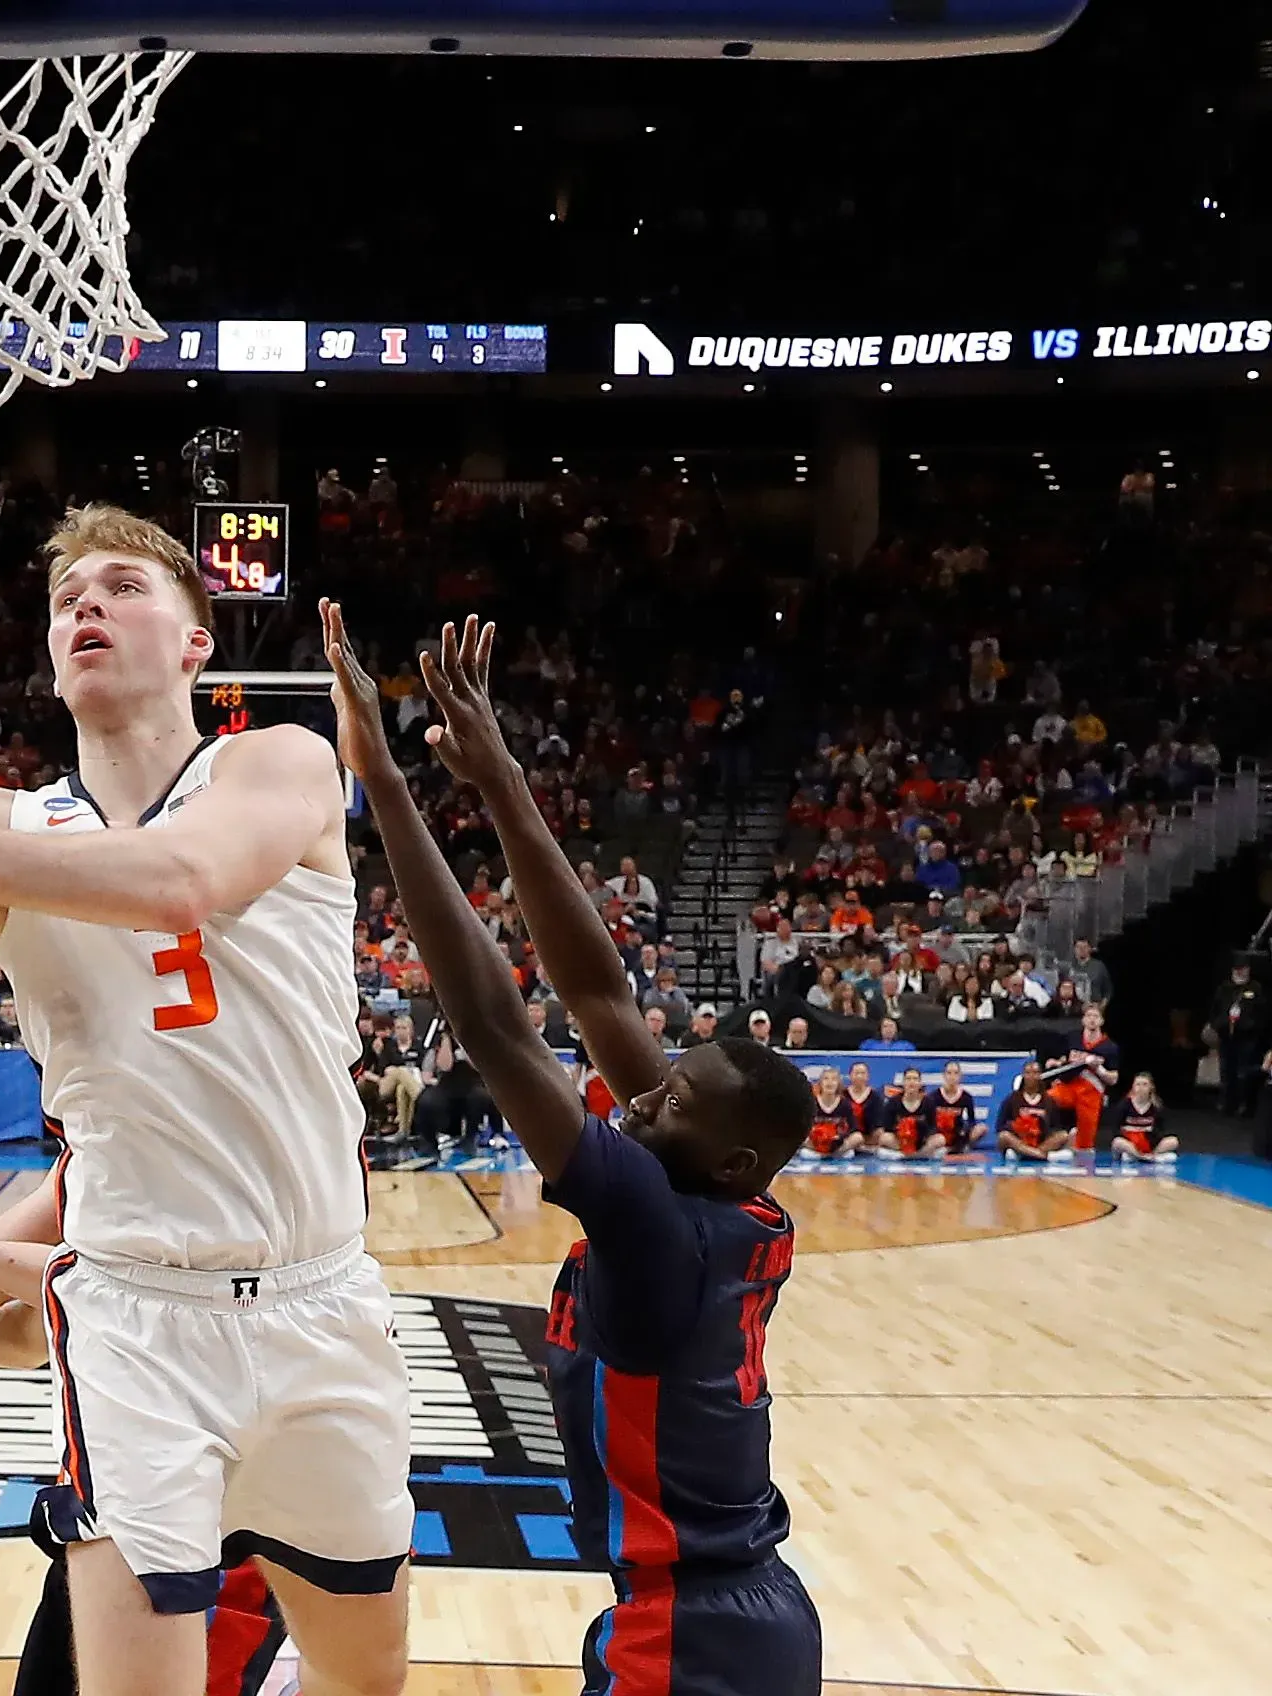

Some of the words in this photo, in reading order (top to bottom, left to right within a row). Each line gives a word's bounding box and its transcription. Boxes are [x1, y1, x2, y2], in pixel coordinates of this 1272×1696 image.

[180, 331, 201, 359] 11
[318, 331, 355, 358] 30
[432, 344, 444, 364] 4
[472, 344, 485, 364] 3
[688, 336, 883, 372] DUQUESNE
[890, 331, 1013, 365] DUKES
[1032, 329, 1078, 358] VS
[1093, 320, 1272, 357] ILLINOIS
[221, 513, 278, 540] 8:34
[212, 543, 265, 588] 4.8
[152, 928, 219, 1031] 3
